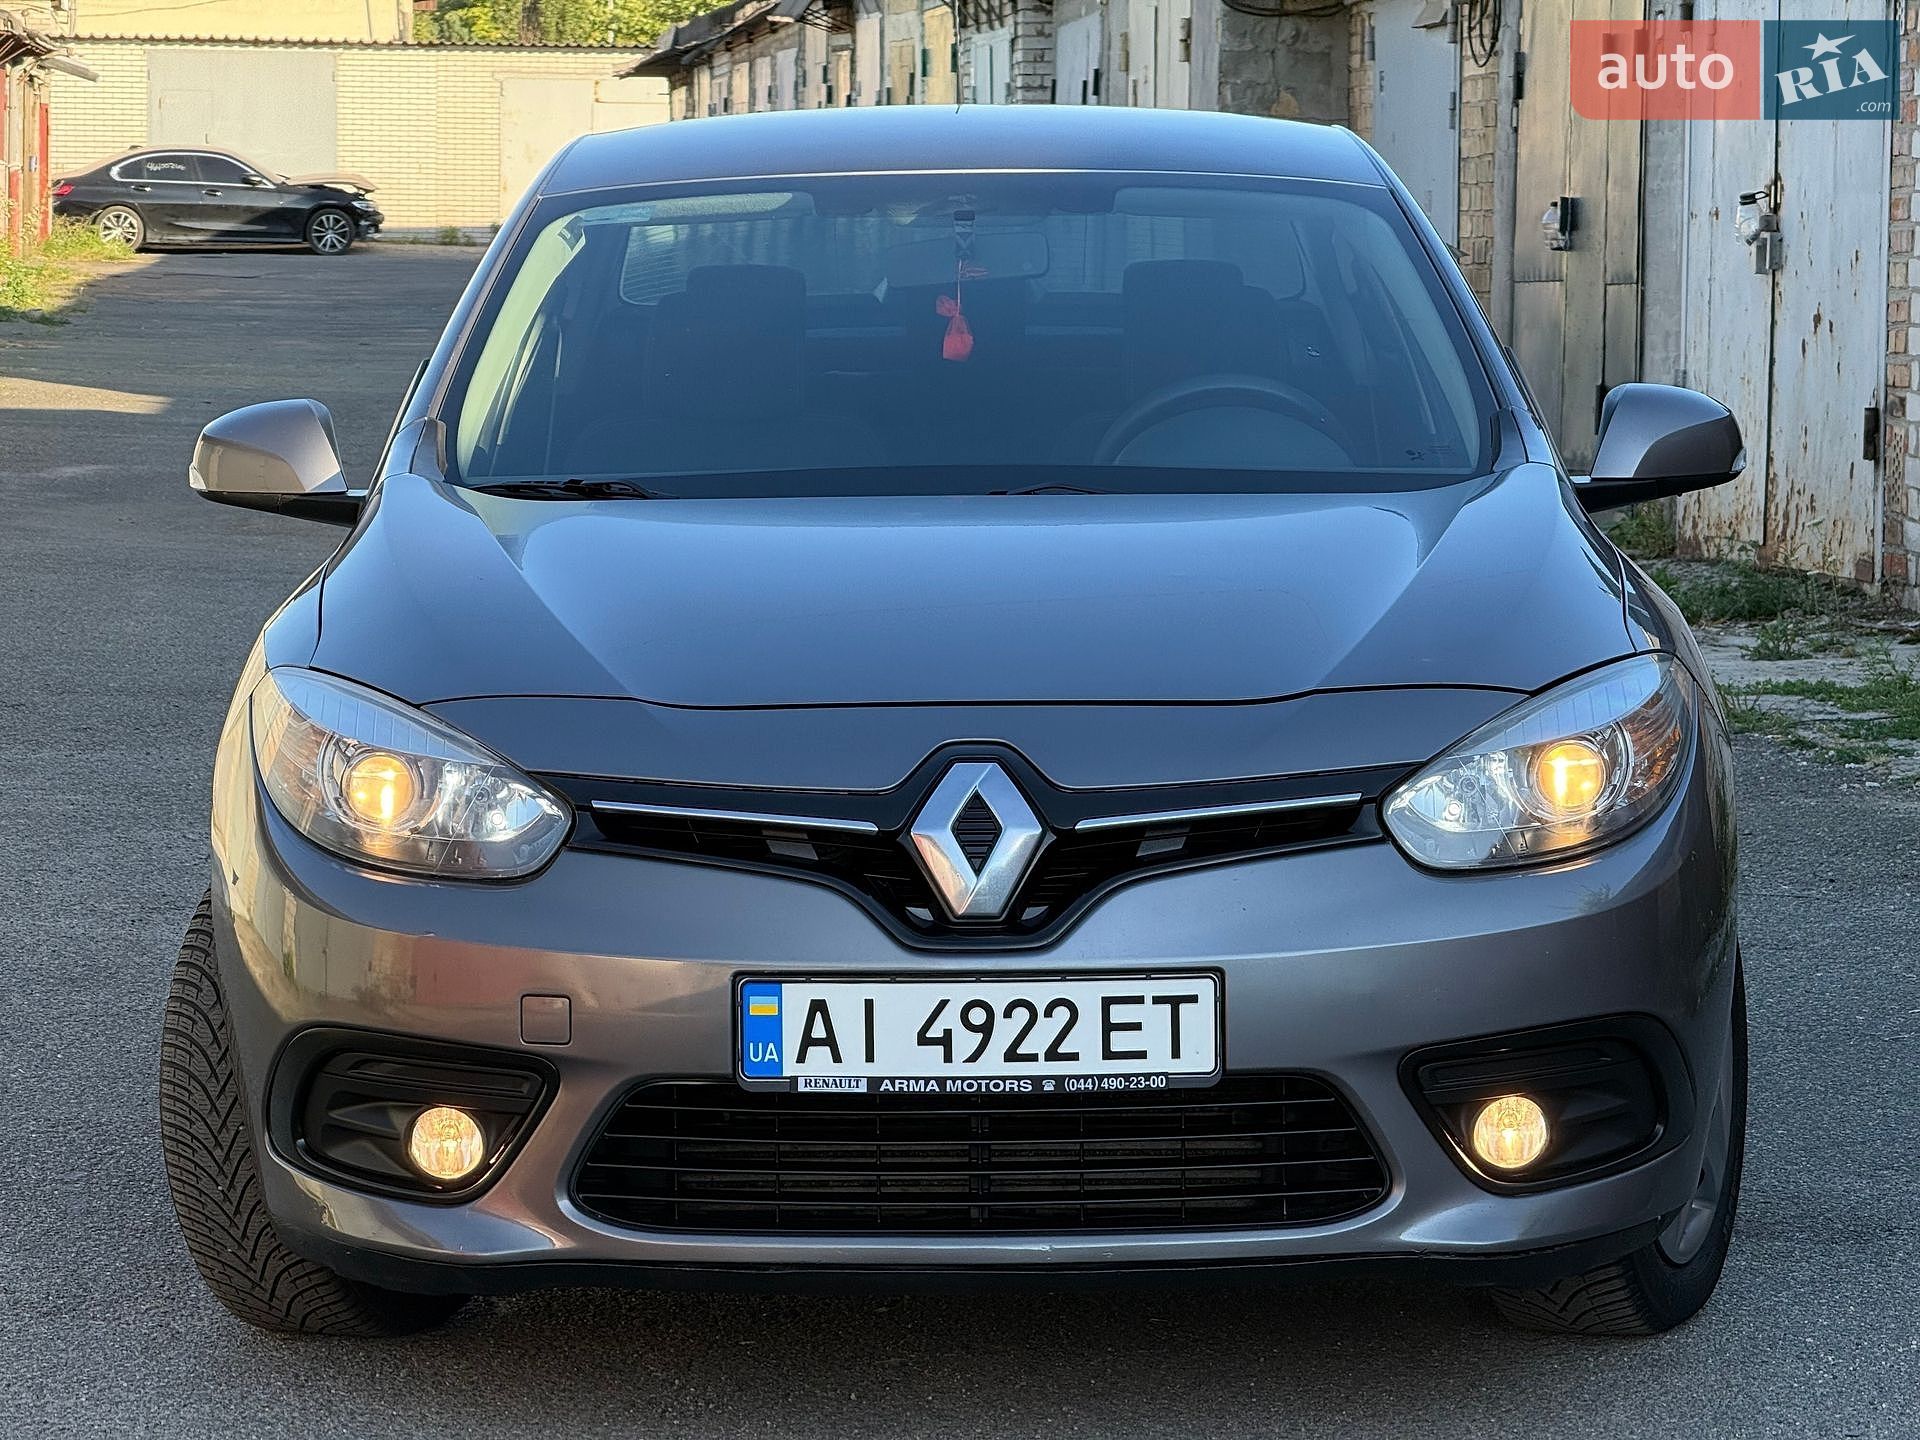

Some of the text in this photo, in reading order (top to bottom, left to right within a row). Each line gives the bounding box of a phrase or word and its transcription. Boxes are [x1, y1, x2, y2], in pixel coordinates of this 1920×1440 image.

[795, 994, 1199, 1064] AI 4922 ET
[749, 1042, 779, 1063] UA
[803, 1077, 862, 1090] RENAULT
[879, 1079, 940, 1092] ARMA
[945, 1079, 1032, 1093] MOTORS
[1101, 1075, 1166, 1091] 490-23-00
